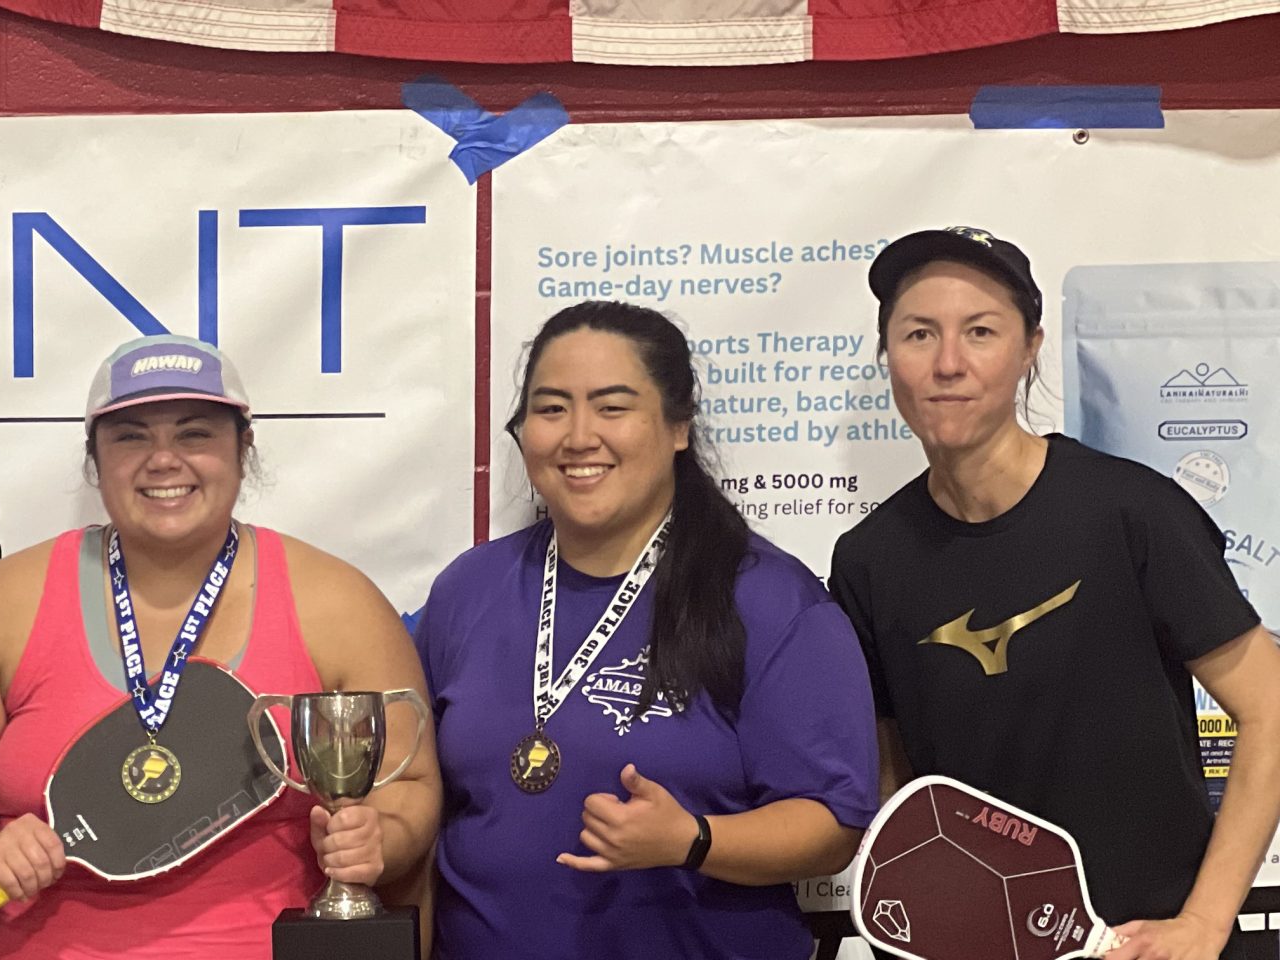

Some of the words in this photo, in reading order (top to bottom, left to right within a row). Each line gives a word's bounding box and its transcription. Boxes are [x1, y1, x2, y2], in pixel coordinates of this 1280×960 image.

[537, 246, 598, 268] Sore
[602, 244, 693, 272] joints?
[700, 241, 794, 265] Muscle
[537, 275, 673, 301] Game-day
[680, 272, 783, 295] nerves?
[757, 331, 864, 357] Therapy
[707, 362, 767, 385] built
[774, 361, 812, 382] for
[819, 361, 890, 381] recov
[797, 388, 891, 412] backed
[808, 420, 839, 447] by
[847, 418, 914, 441] athle
[1166, 425, 1238, 436] EUCALYPTUS
[754, 475, 766, 490] &
[772, 474, 824, 489] 5000
[830, 475, 858, 492] mg
[774, 498, 822, 515] relief
[828, 499, 855, 515] for
[115, 590, 132, 618] 1ST
[180, 615, 201, 642] 1ST
[194, 561, 229, 618] PLACE
[540, 577, 554, 632] PLACE
[574, 639, 599, 670] 3RD
[596, 580, 642, 638] PLACE
[120, 620, 143, 678] PLACE
[972, 806, 1039, 846] RUBY
